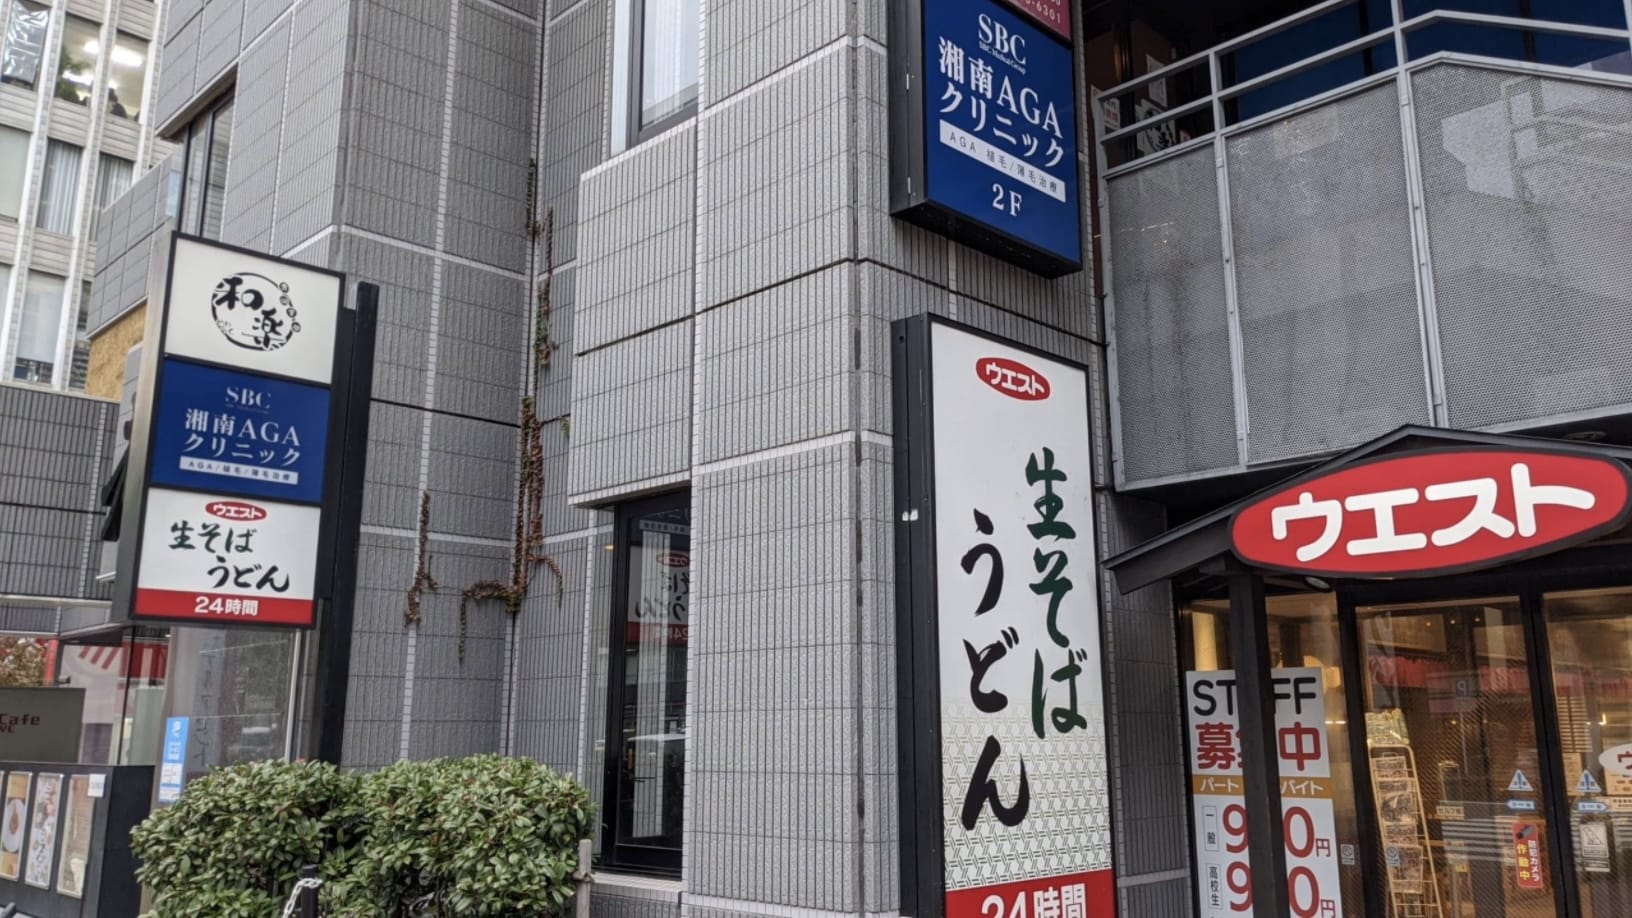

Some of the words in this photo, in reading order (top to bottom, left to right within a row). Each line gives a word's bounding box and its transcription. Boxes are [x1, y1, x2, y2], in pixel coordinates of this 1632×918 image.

[978, 13, 1026, 65] SBC
[938, 36, 1063, 139] 湘南AGA
[940, 82, 1064, 167] クリニック
[950, 132, 976, 153] AGA
[992, 183, 1023, 216] 2F
[225, 386, 271, 408] SBC
[985, 362, 1044, 395] ウエスト
[184, 408, 300, 446] 湘南AGA
[183, 433, 300, 466] クリニック
[213, 504, 262, 519] ウエスト
[1271, 462, 1596, 562] ウエスト
[168, 520, 257, 553] 生そば
[207, 555, 290, 593] うどん
[1025, 446, 1088, 739] 生そば
[194, 596, 259, 616] 24時間
[960, 508, 1030, 831] うどん
[1193, 677, 1316, 716] STFF
[1195, 721, 1321, 771] 募中
[1222, 804, 1331, 859] 90円
[981, 883, 1088, 918] 24時間
[1226, 861, 1336, 918] 90円
